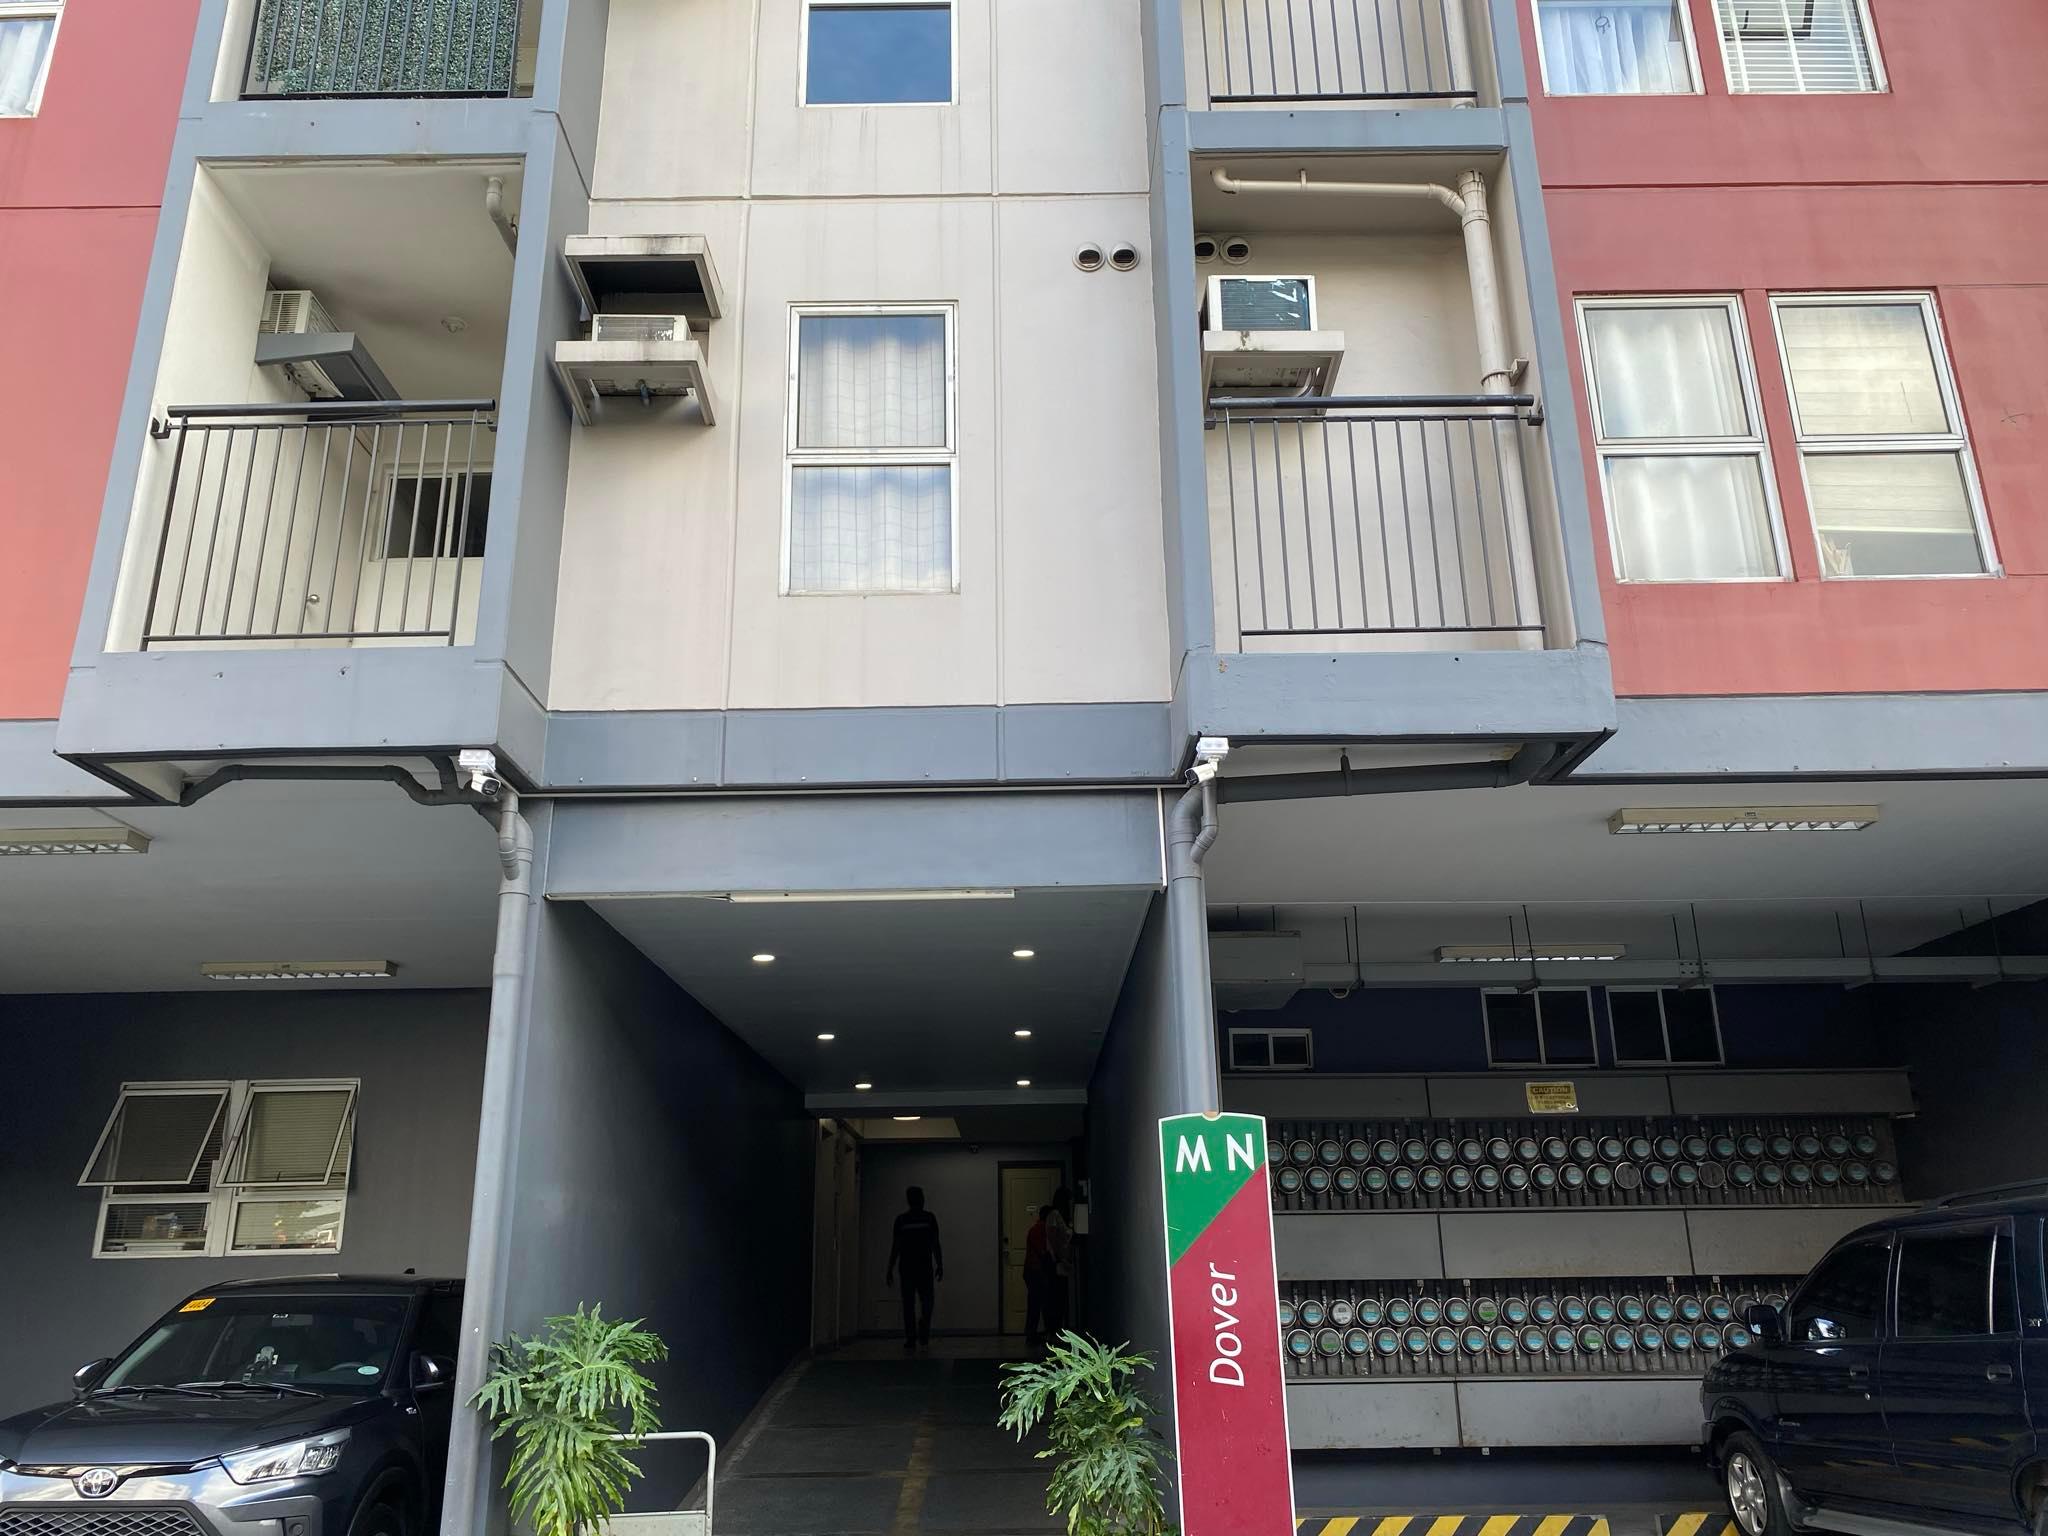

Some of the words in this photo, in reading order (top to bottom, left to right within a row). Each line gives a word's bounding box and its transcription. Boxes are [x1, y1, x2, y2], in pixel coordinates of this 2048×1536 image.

[1532, 1086, 1569, 1094] CAUTION
[1175, 1134, 1212, 1173] M
[1226, 1133, 1255, 1171] N
[1209, 1261, 1245, 1387] Dover
